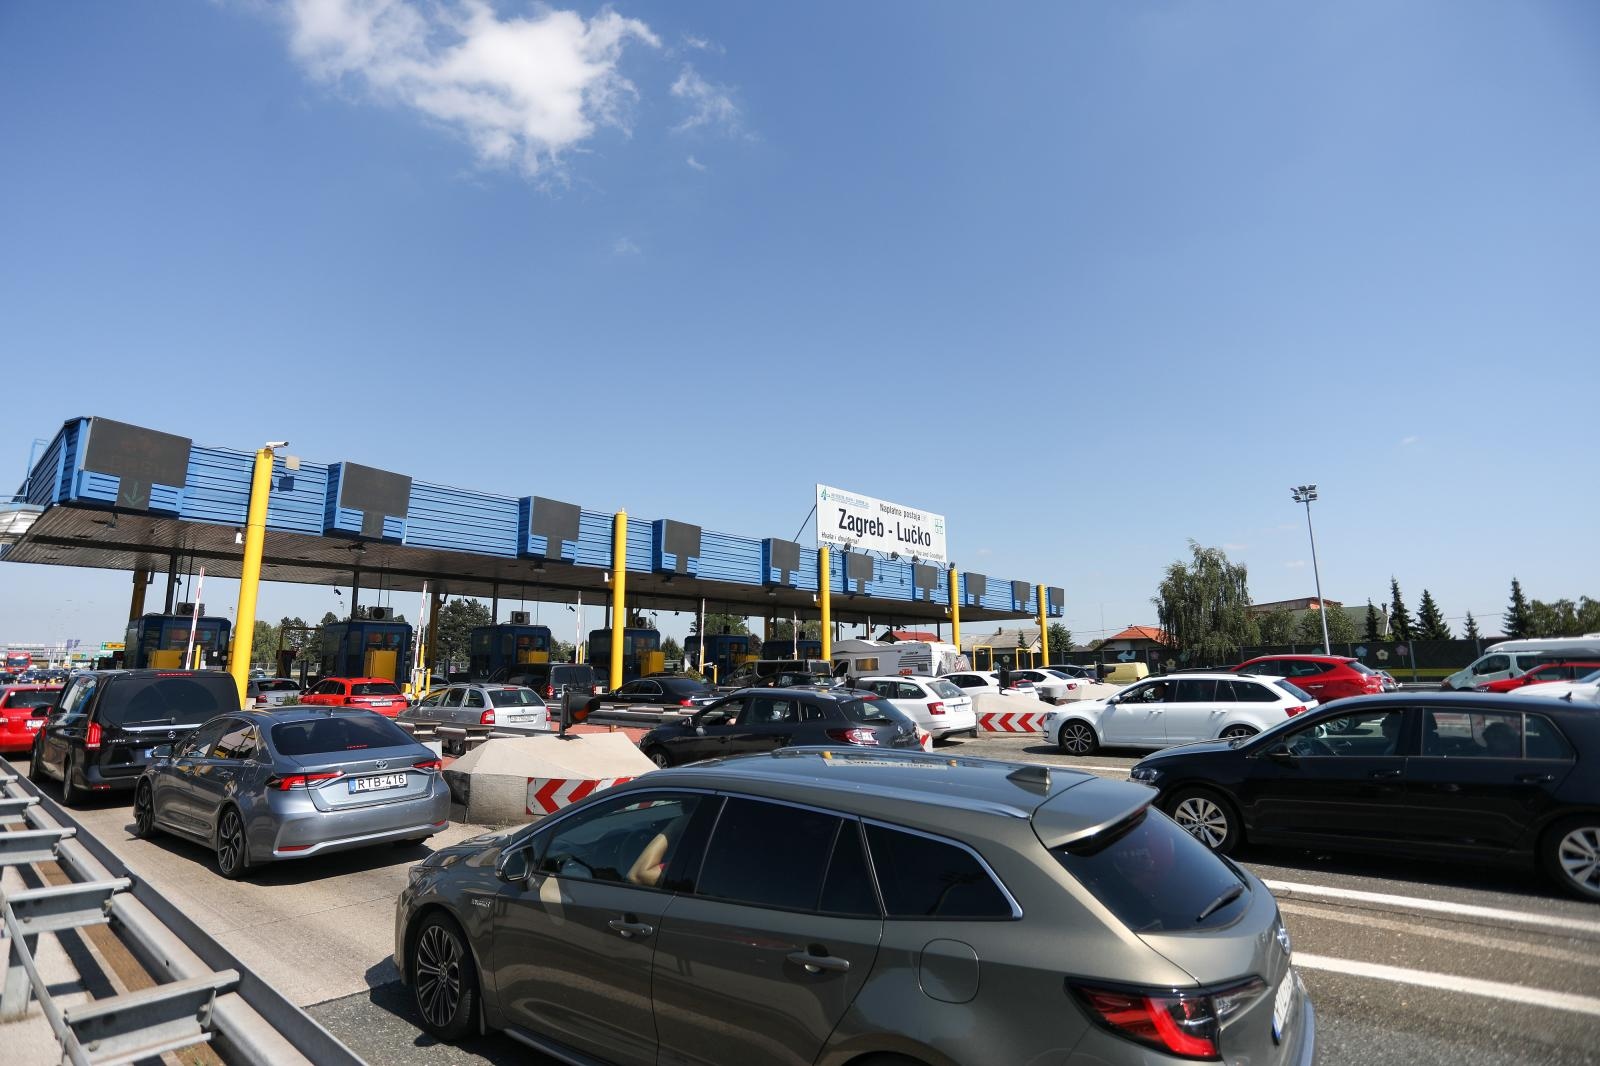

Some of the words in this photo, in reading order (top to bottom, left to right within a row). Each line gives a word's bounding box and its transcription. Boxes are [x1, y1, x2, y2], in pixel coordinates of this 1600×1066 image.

[879, 503, 902, 517] Naplatna
[903, 510, 921, 521] postaja
[838, 508, 884, 538] Zagreb
[897, 521, 931, 547] Lučko
[358, 774, 405, 789] RTB-416
